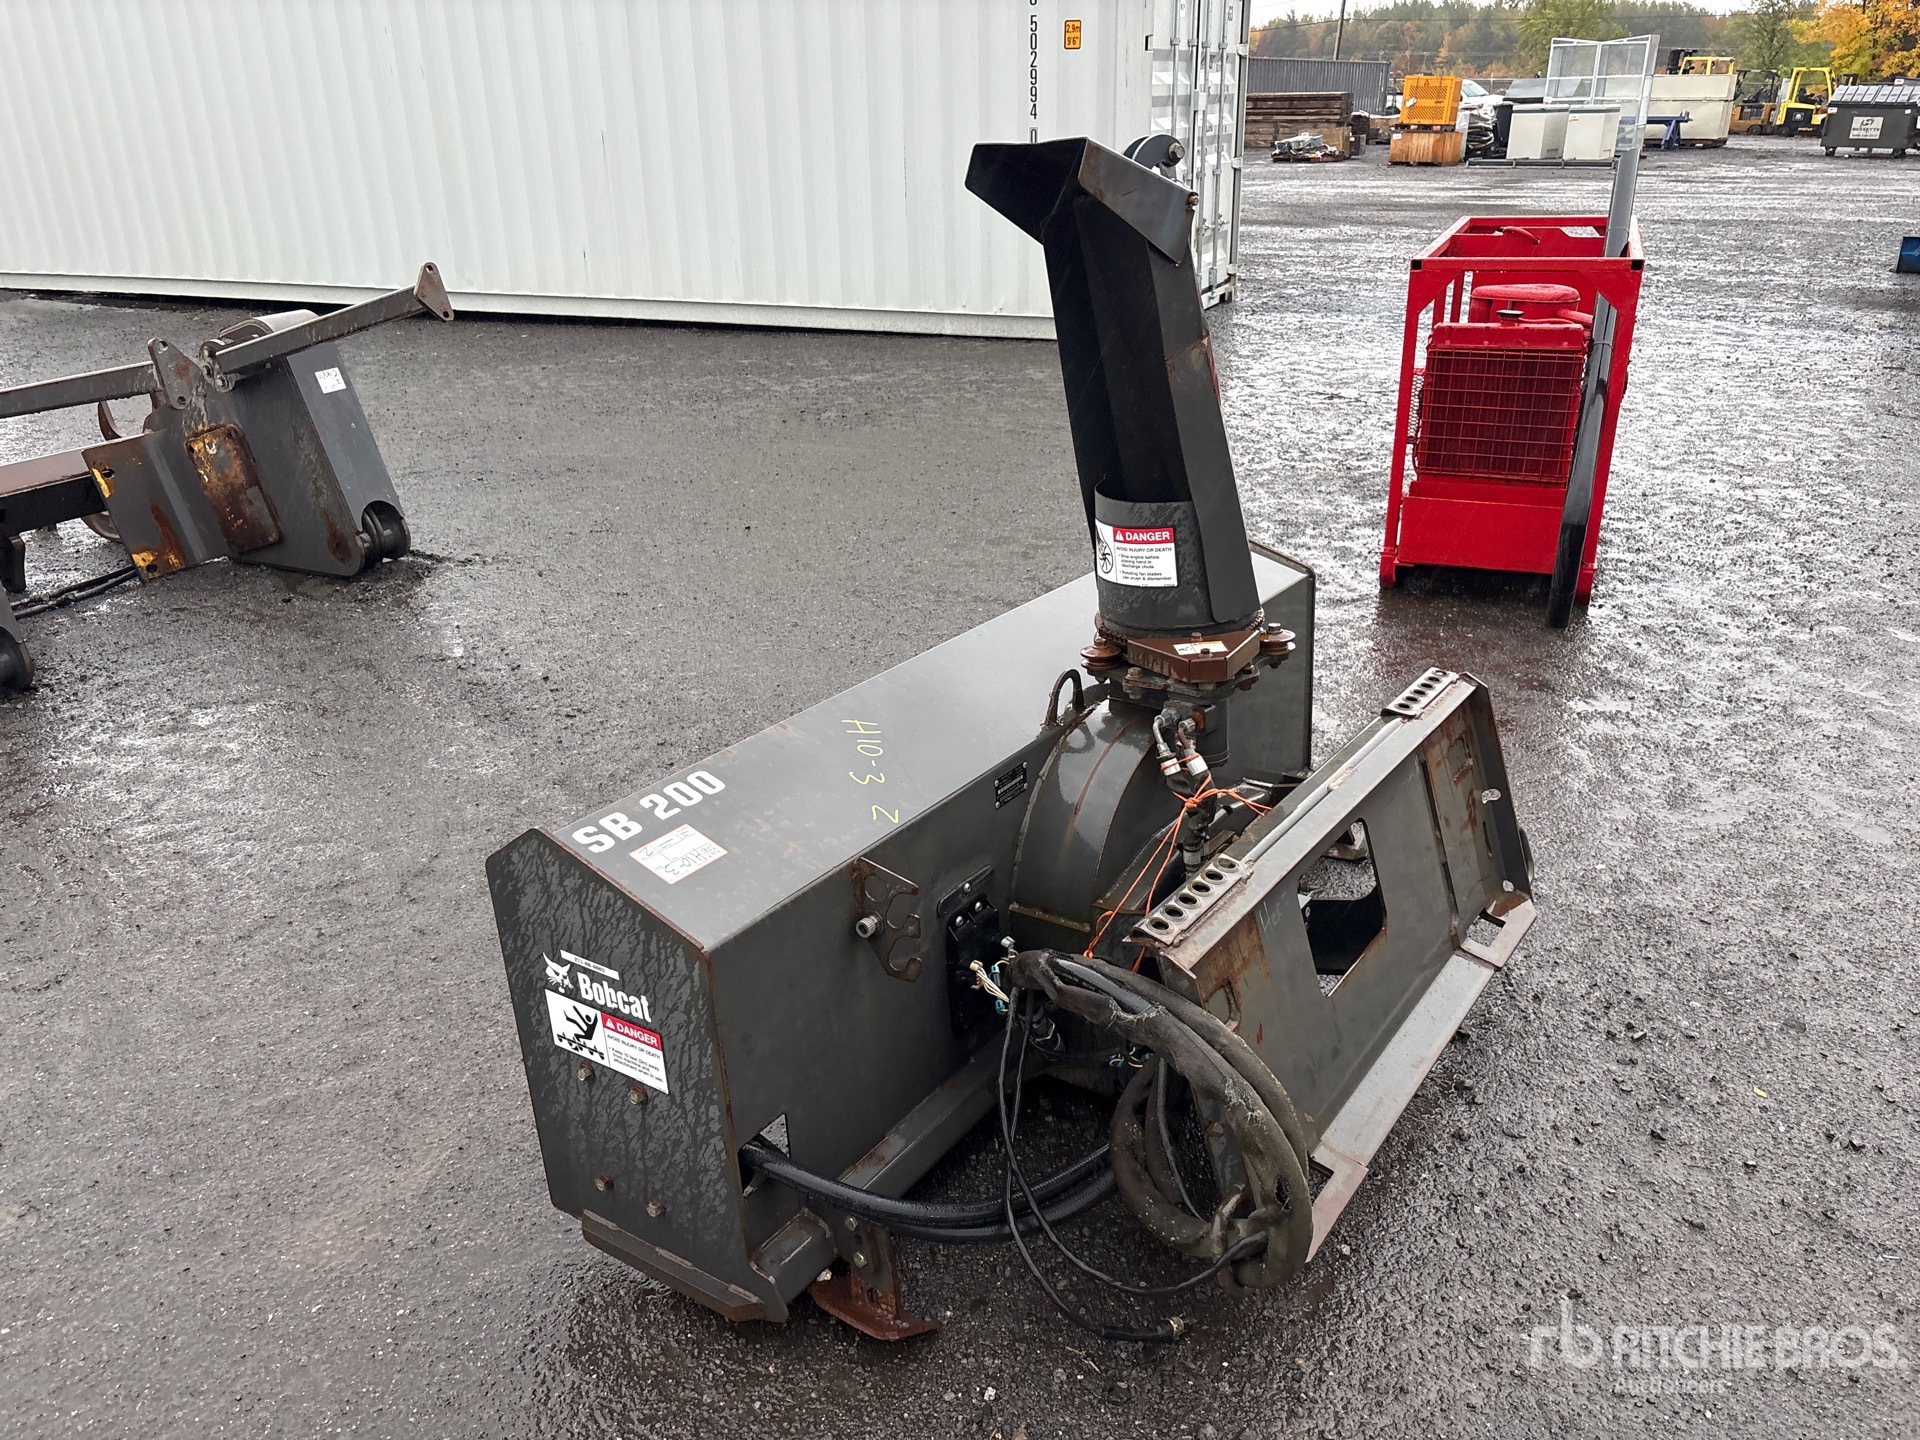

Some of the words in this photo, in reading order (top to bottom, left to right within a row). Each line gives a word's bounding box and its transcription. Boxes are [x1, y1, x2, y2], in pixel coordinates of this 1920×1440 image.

[1029, 14, 1038, 120] 502994
[1125, 531, 1171, 542] DANGER
[571, 811, 643, 853] SB
[639, 770, 727, 821] 200
[576, 971, 652, 1023] Bobcat
[616, 1022, 659, 1047] DANGER
